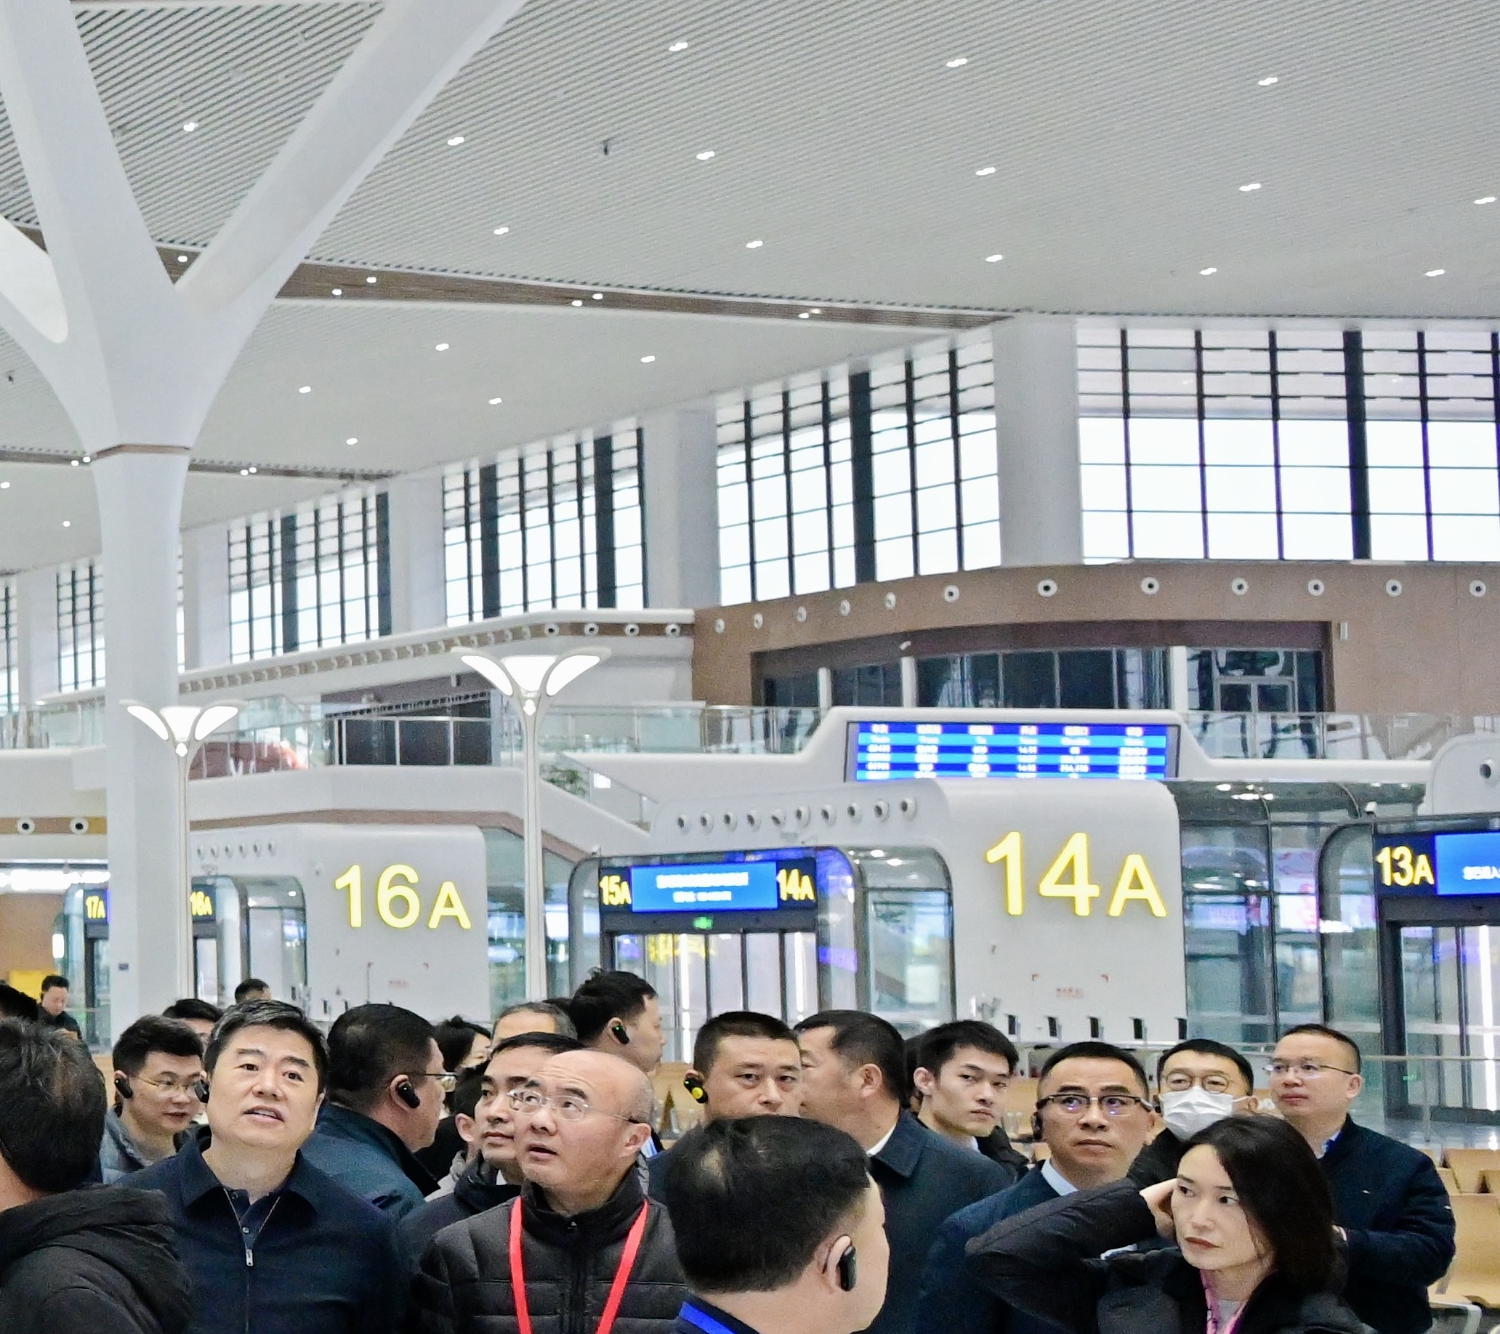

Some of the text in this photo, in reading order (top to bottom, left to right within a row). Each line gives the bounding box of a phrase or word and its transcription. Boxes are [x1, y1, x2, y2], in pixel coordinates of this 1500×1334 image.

[984, 831, 1168, 917] 14A
[1376, 846, 1435, 886] 13A
[333, 863, 472, 930] 16A
[600, 875, 632, 906] 15A
[777, 869, 816, 901] 14A
[85, 896, 105, 919] 17A
